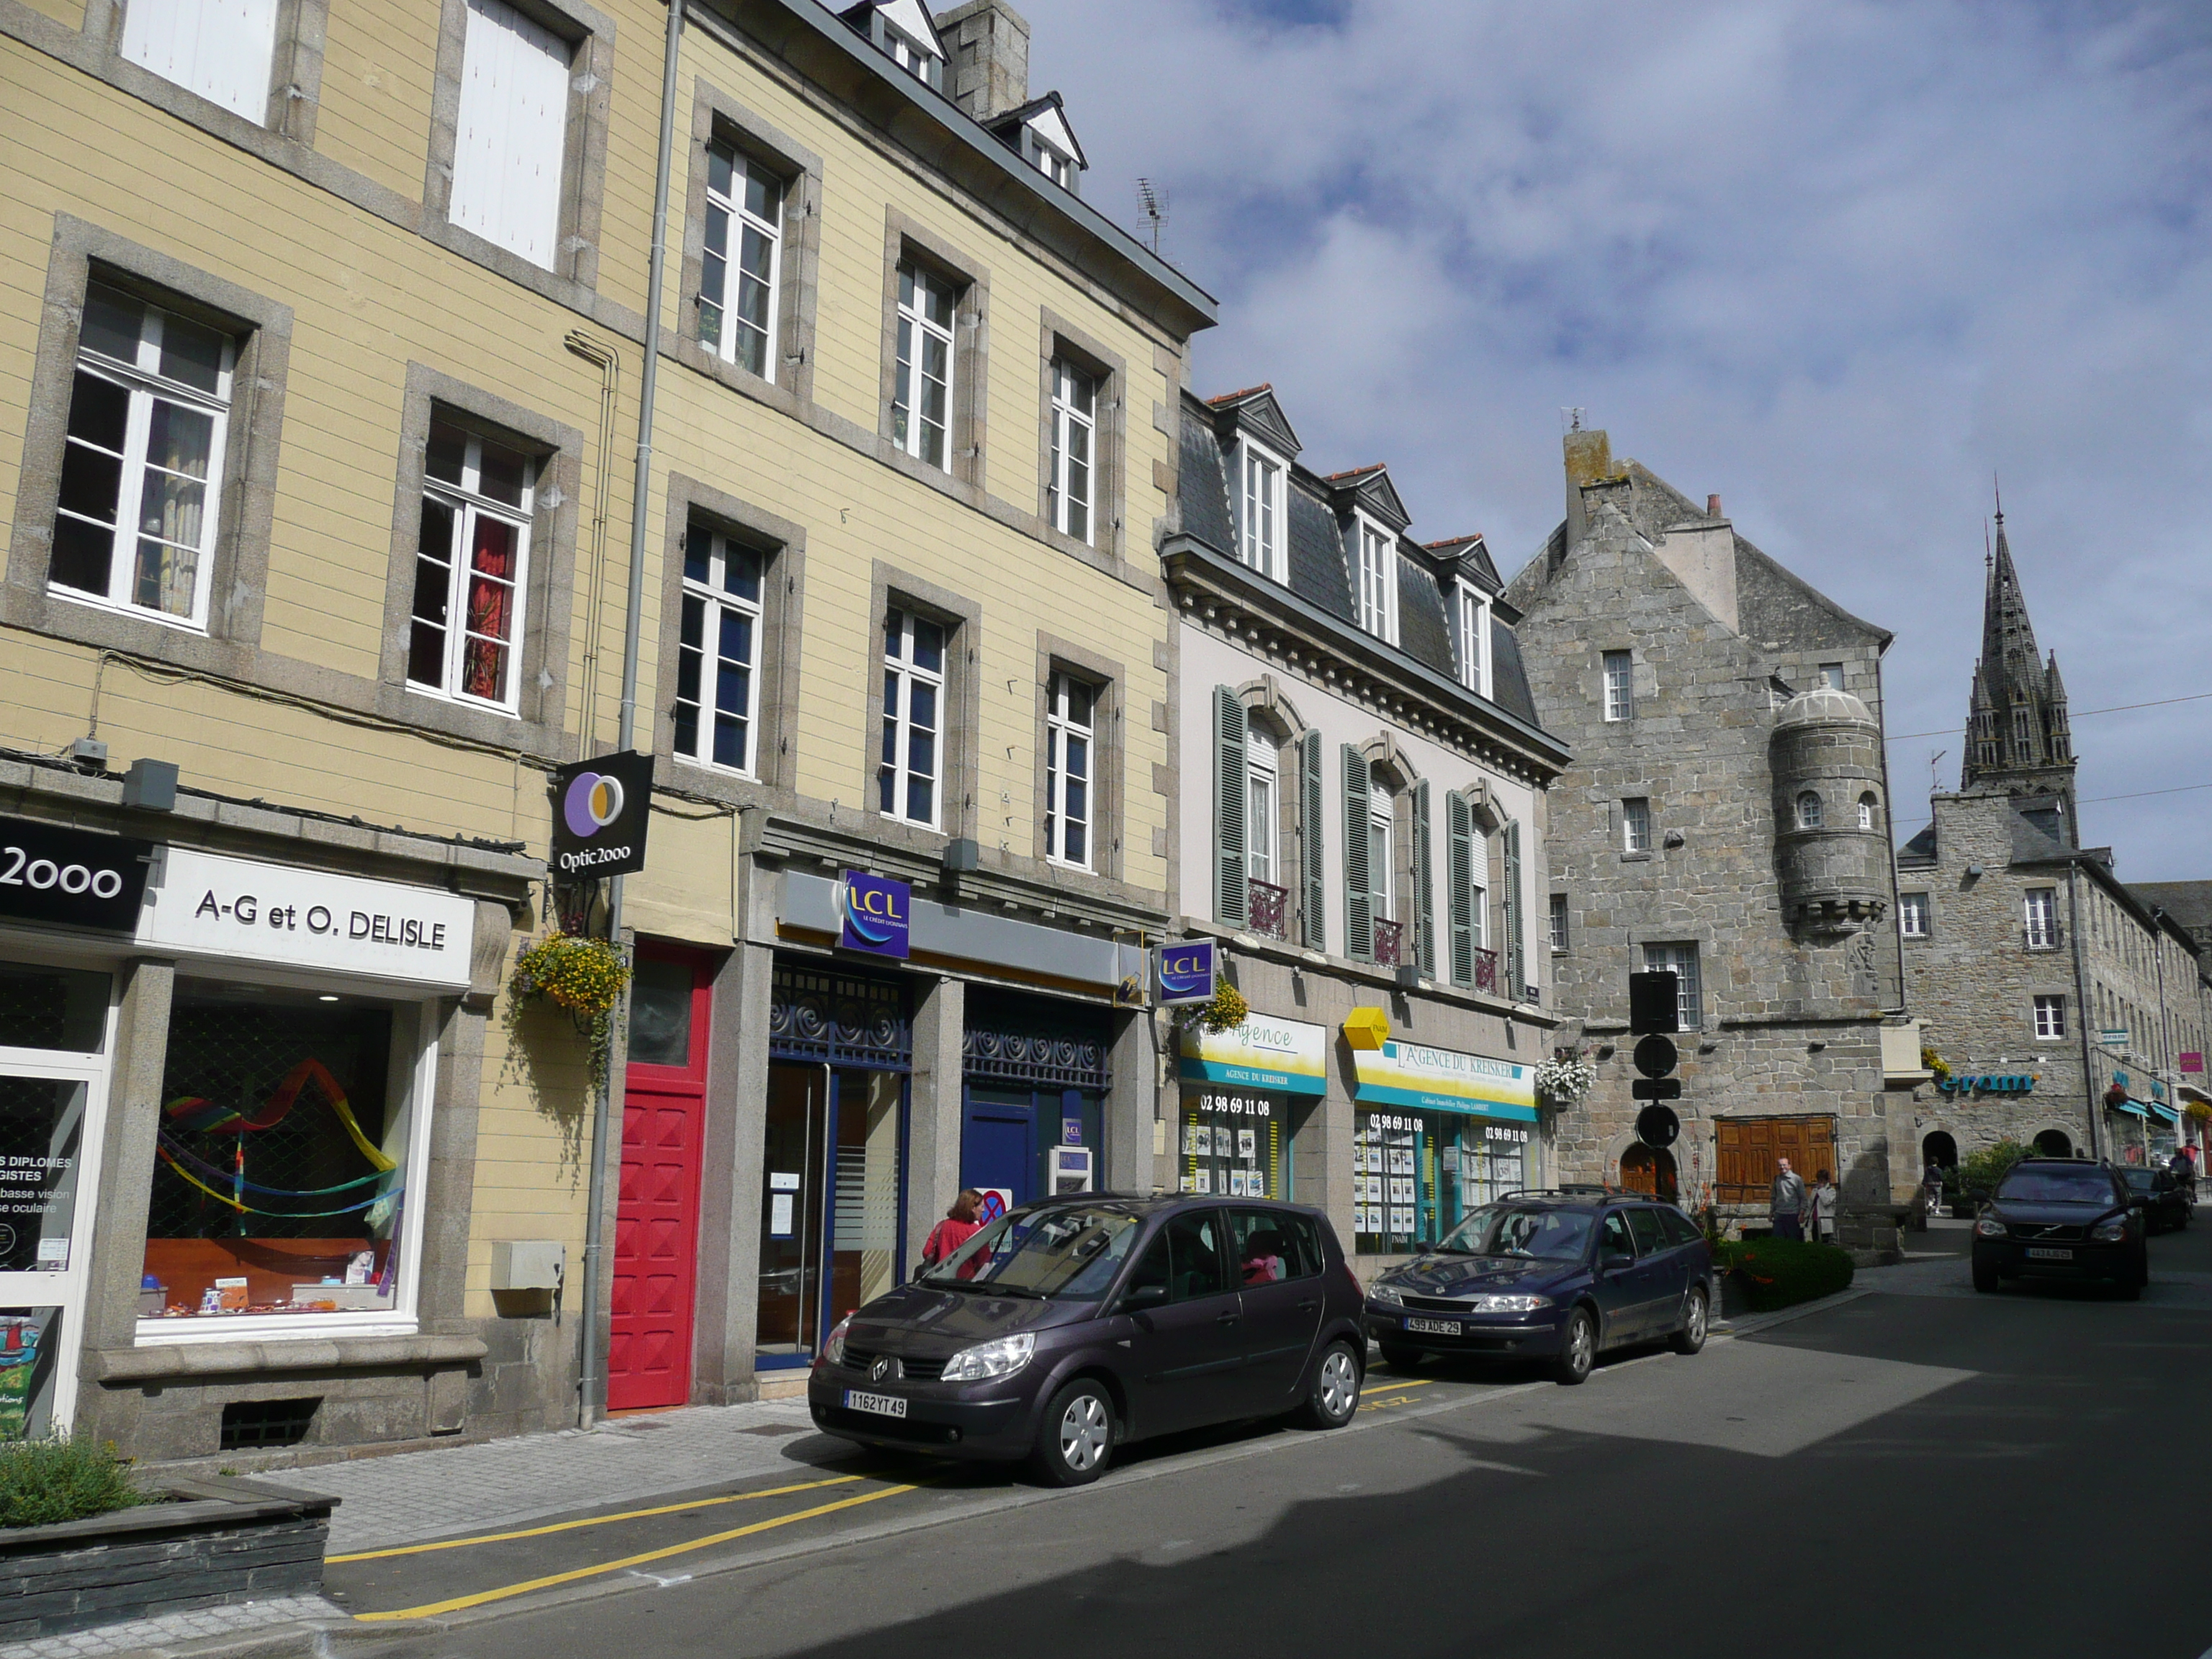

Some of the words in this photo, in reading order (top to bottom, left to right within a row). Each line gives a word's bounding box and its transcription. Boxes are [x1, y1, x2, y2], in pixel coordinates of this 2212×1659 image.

[0, 846, 122, 899] 2000
[850, 886, 902, 919] LCL
[195, 889, 258, 925] A-G
[269, 904, 296, 931] et
[307, 905, 338, 935] O.
[349, 911, 446, 950] DELISLE
[1163, 957, 1205, 975] LCL
[1453, 1054, 1466, 1071] DU
[1470, 1057, 1512, 1078] KREISKER
[1226, 1069, 1249, 1080] AGENCE
[1262, 1074, 1288, 1085] KREISKER
[1940, 1075, 2033, 1092] eram
[1200, 1094, 1213, 1110] 02
[1215, 1096, 1228, 1112] 98
[1230, 1097, 1242, 1113] 69
[1245, 1100, 1255, 1115] 11
[1258, 1100, 1269, 1116] 08
[1370, 1113, 1380, 1128] 02
[1382, 1114, 1391, 1129] 98
[1393, 1115, 1402, 1130] 69
[1404, 1117, 1412, 1130] 11
[1413, 1118, 1423, 1132] 08
[1485, 1126, 1494, 1139] 02
[1495, 1128, 1503, 1140] 98
[1503, 1128, 1511, 1141] 69
[1513, 1130, 1519, 1142] 11
[1520, 1130, 1528, 1143] 08
[9, 1156, 72, 1168] DIPLOMES
[1, 1187, 35, 1199] basse
[38, 1188, 70, 1199] vision
[12, 1202, 57, 1213] oculaire
[1409, 1318, 1426, 1331] 499
[1428, 1321, 1445, 1332] ADE
[1447, 1322, 1459, 1334] 29
